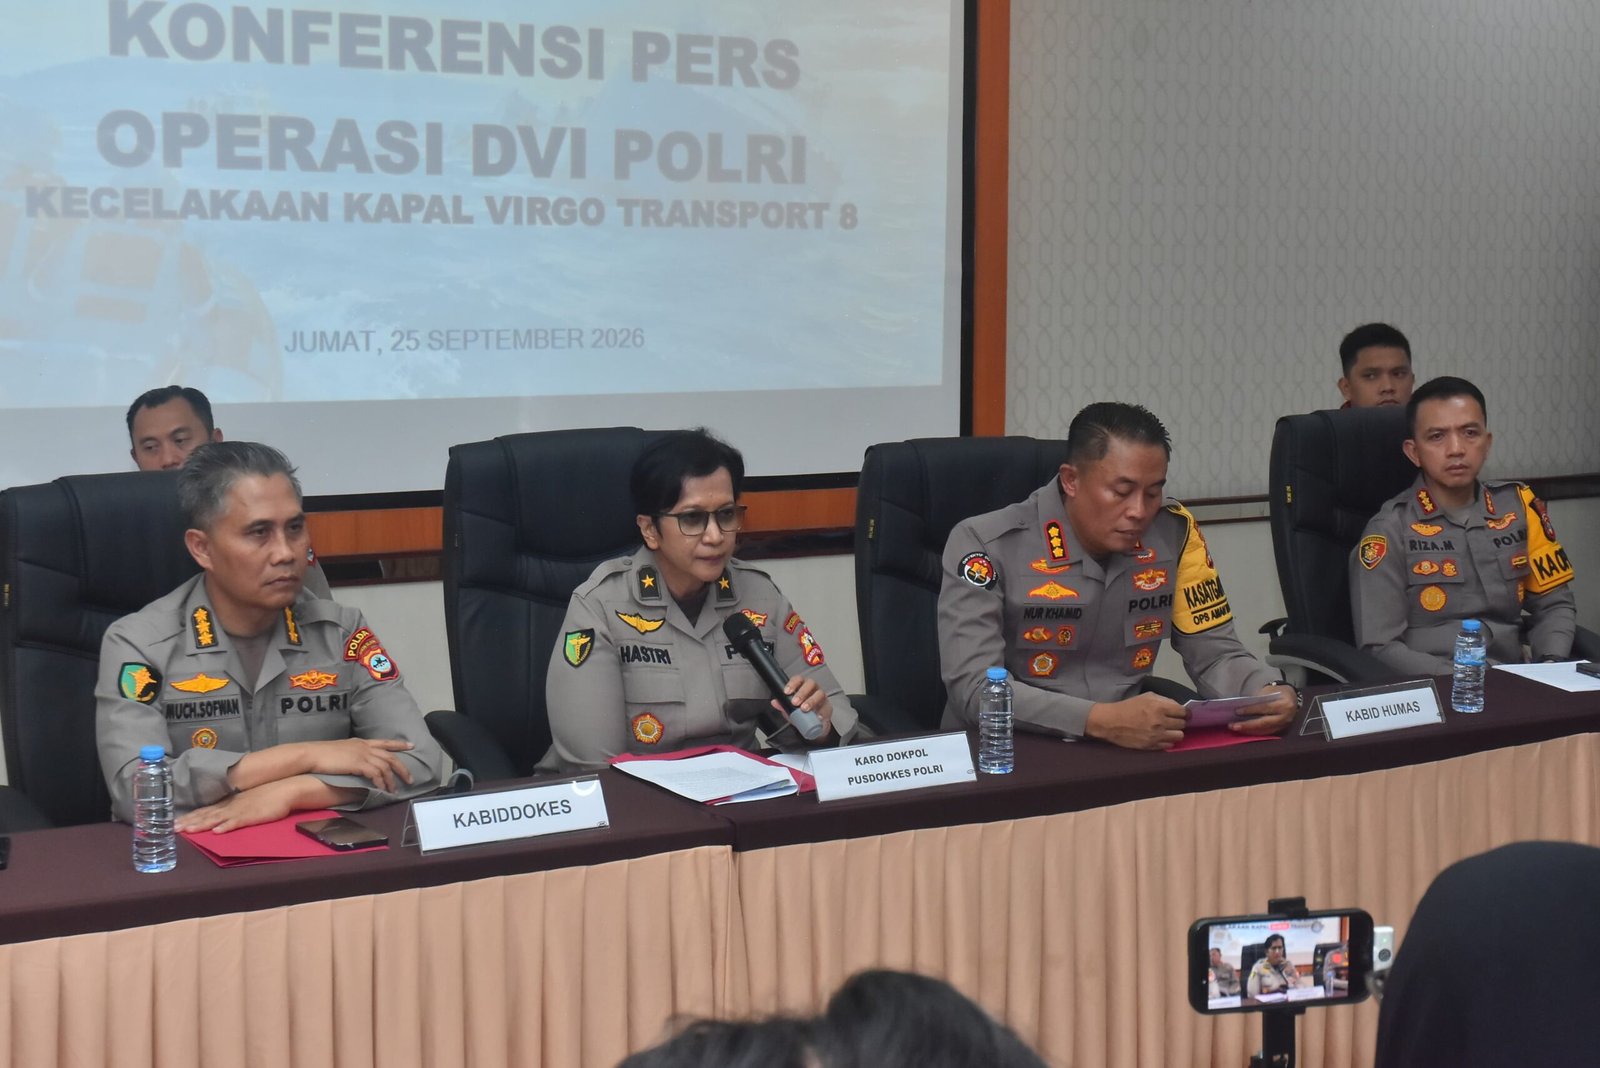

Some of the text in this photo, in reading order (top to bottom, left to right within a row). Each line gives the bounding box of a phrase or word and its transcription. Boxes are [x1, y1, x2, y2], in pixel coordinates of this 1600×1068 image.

[108, 0, 800, 90] KONFERENSI PERS
[96, 109, 807, 185] OPERASI DVI POLRI
[25, 185, 859, 230] KECELAKAAN KAPAL VIRGO TRANSPORT 8
[284, 328, 646, 356] JUMAT, 25 SEPTEMBER 2026
[1408, 540, 1455, 551] RIZA.M
[1183, 575, 1226, 609] KASATGA
[1024, 607, 1043, 619] NUR
[1128, 593, 1173, 613] POLRI
[1193, 612, 1210, 626] OPS
[347, 630, 370, 657] POLDA
[620, 644, 671, 664] HASTRI
[165, 698, 240, 719] MUCH.SOFWAN
[281, 693, 348, 714] POLRI
[1345, 701, 1421, 722] KABID HUMAS
[854, 748, 929, 766] KARO DOKPOL
[847, 764, 944, 785] PUSDOKKES POLRI
[453, 799, 572, 828] KABIDDOKES
